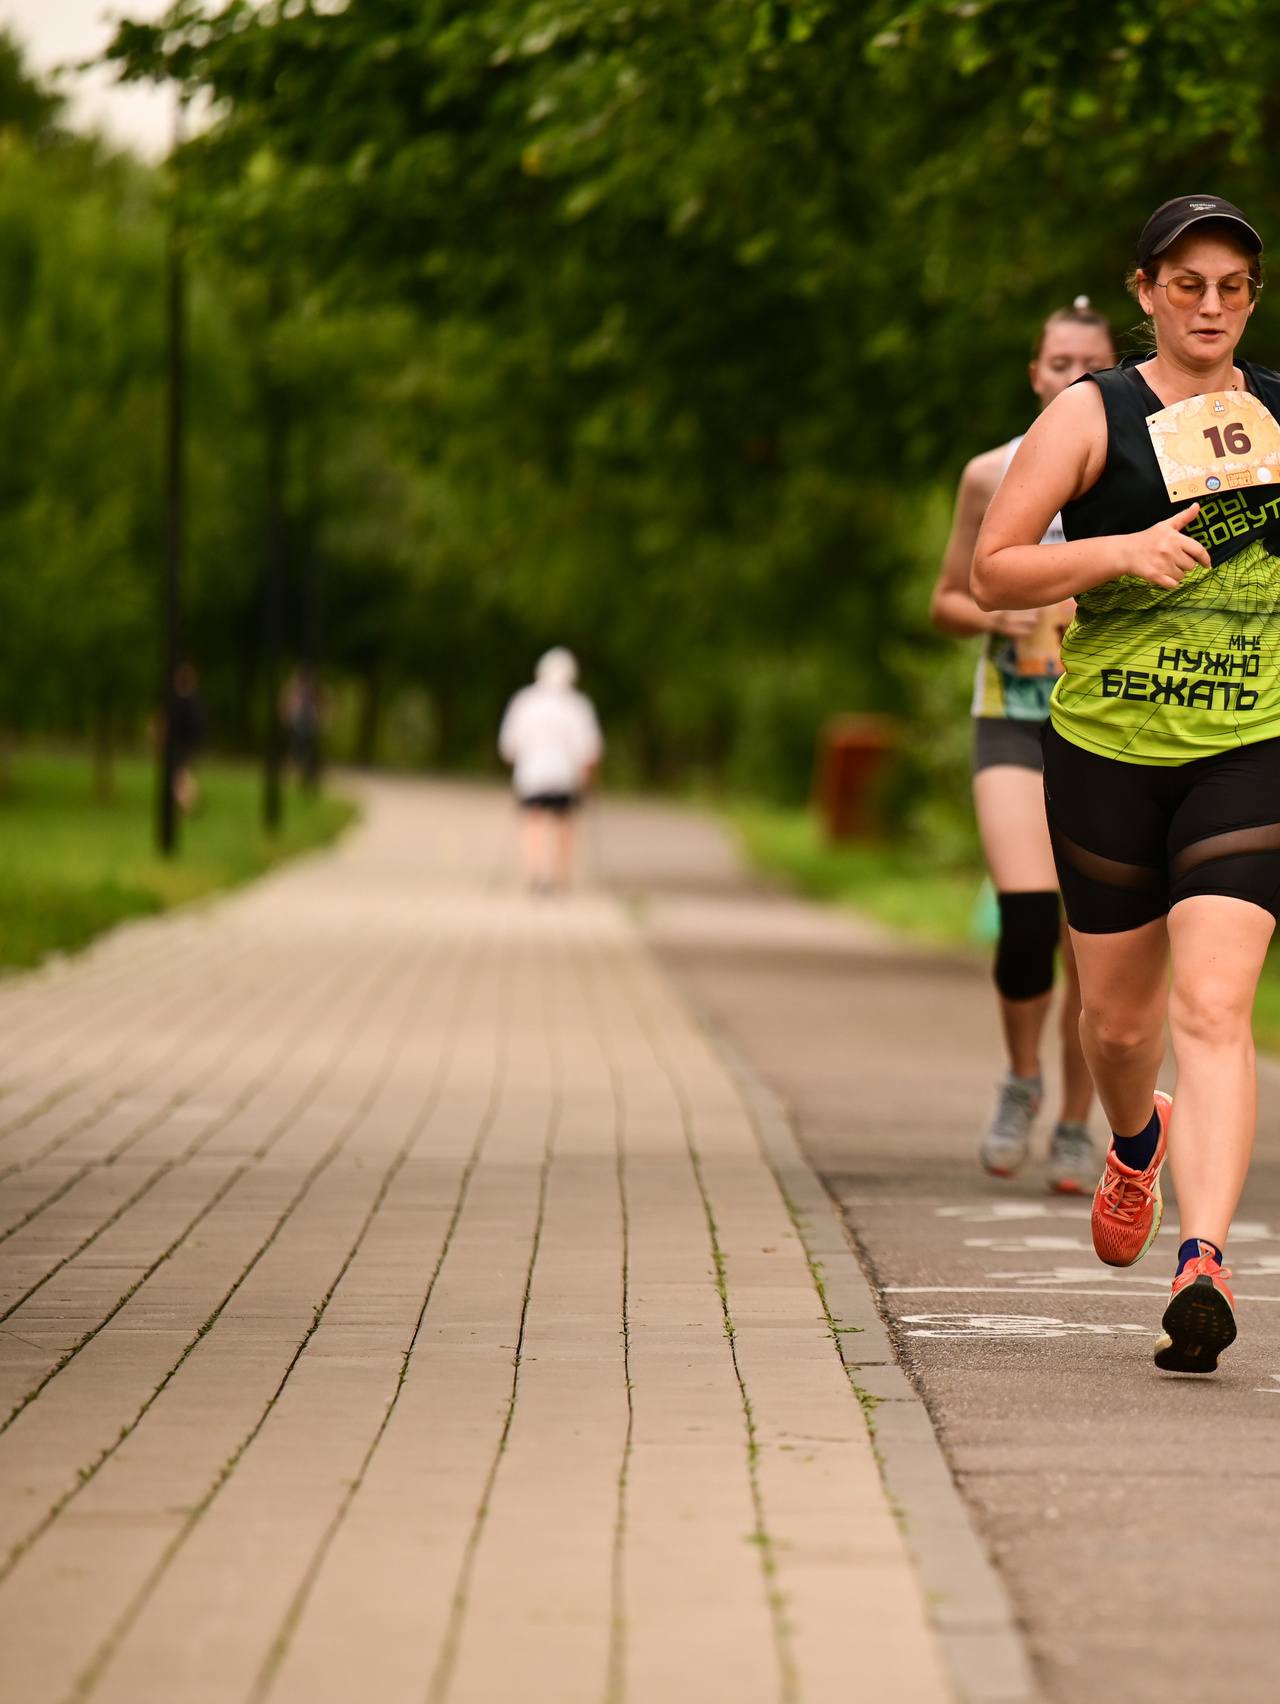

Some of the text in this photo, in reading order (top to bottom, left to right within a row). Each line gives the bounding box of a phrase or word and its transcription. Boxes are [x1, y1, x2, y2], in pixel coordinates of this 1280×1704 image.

[1202, 422, 1251, 458] 16
[1185, 491, 1248, 532] ОРЫ
[1157, 646, 1260, 677] НУЖНО
[1101, 669, 1259, 710] БЕЖАТЬ
